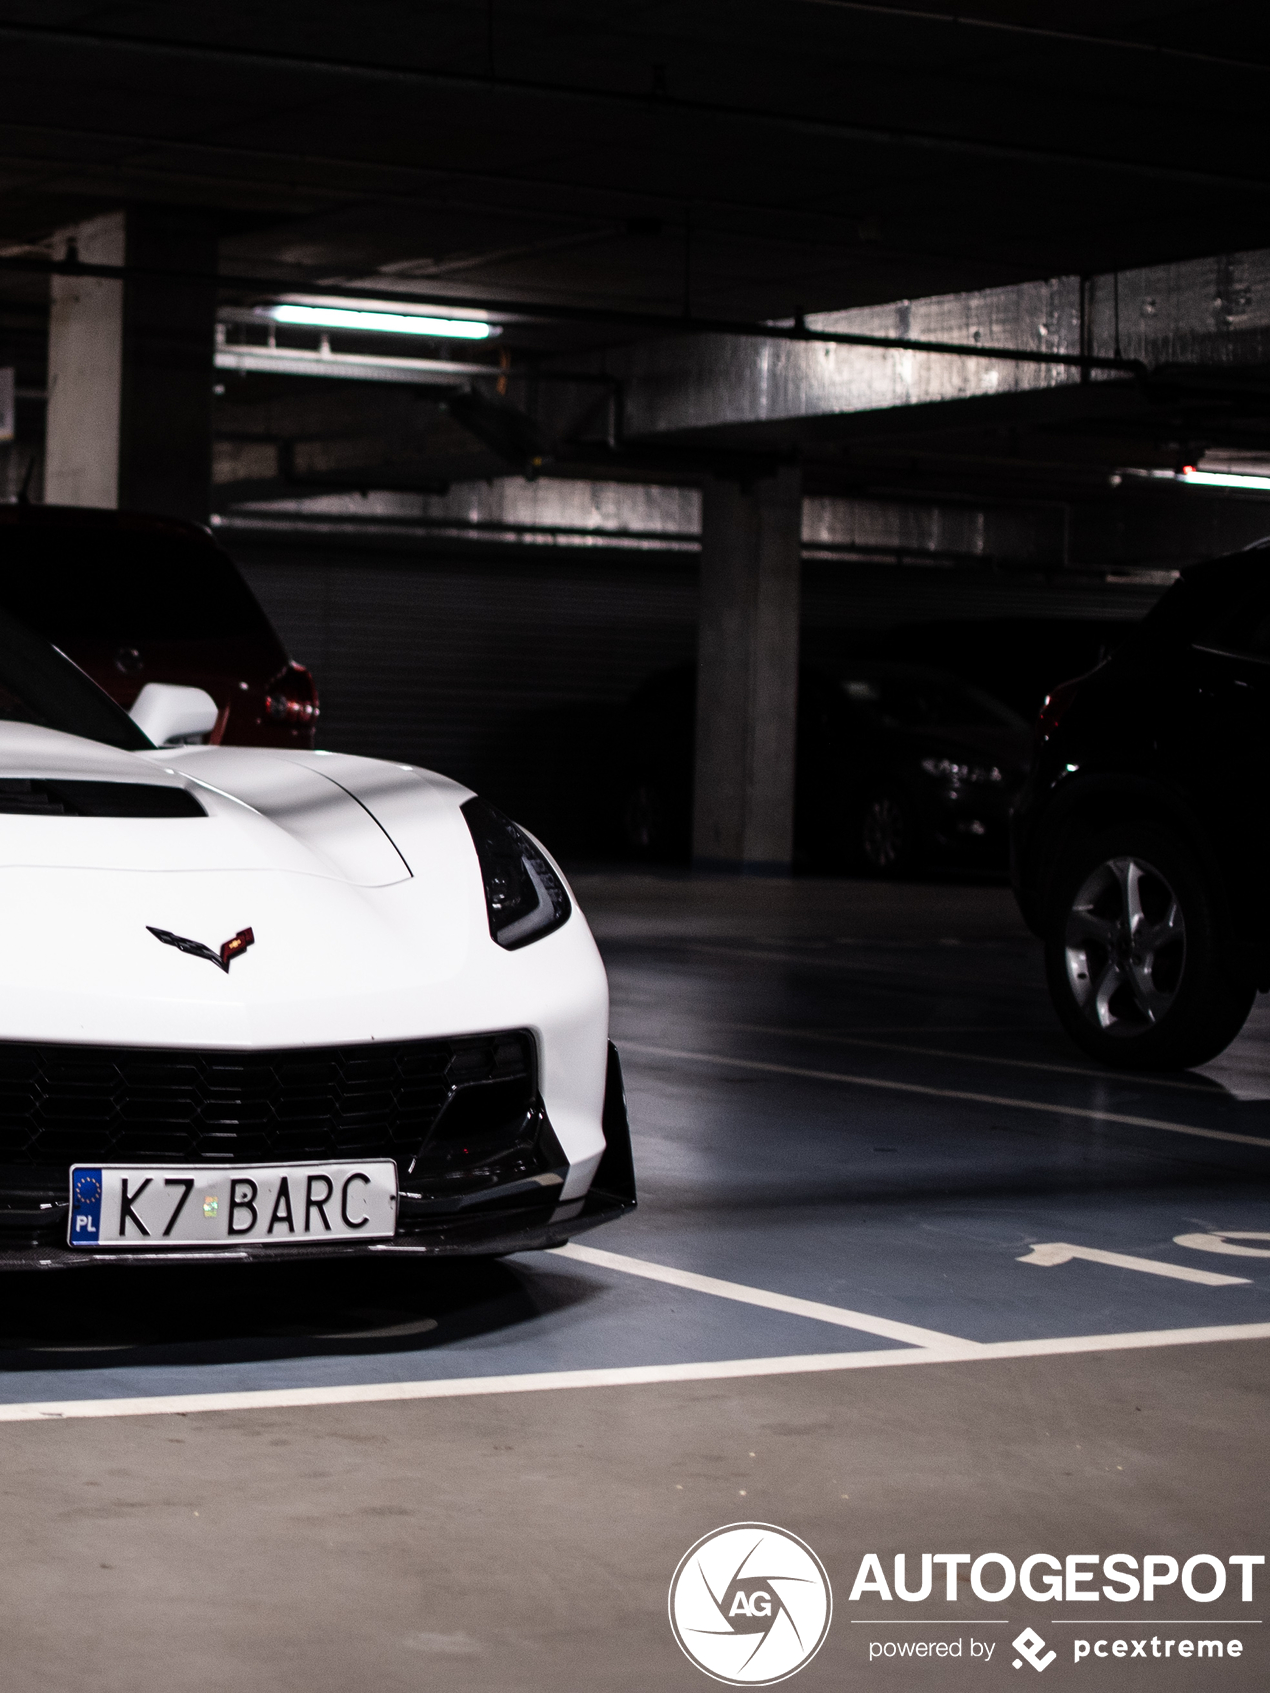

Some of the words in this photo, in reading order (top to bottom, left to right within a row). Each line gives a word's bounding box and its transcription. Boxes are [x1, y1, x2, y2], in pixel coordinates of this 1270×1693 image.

[75, 1214, 97, 1233] PL
[118, 1176, 195, 1237] K7
[227, 1171, 371, 1236] BARC
